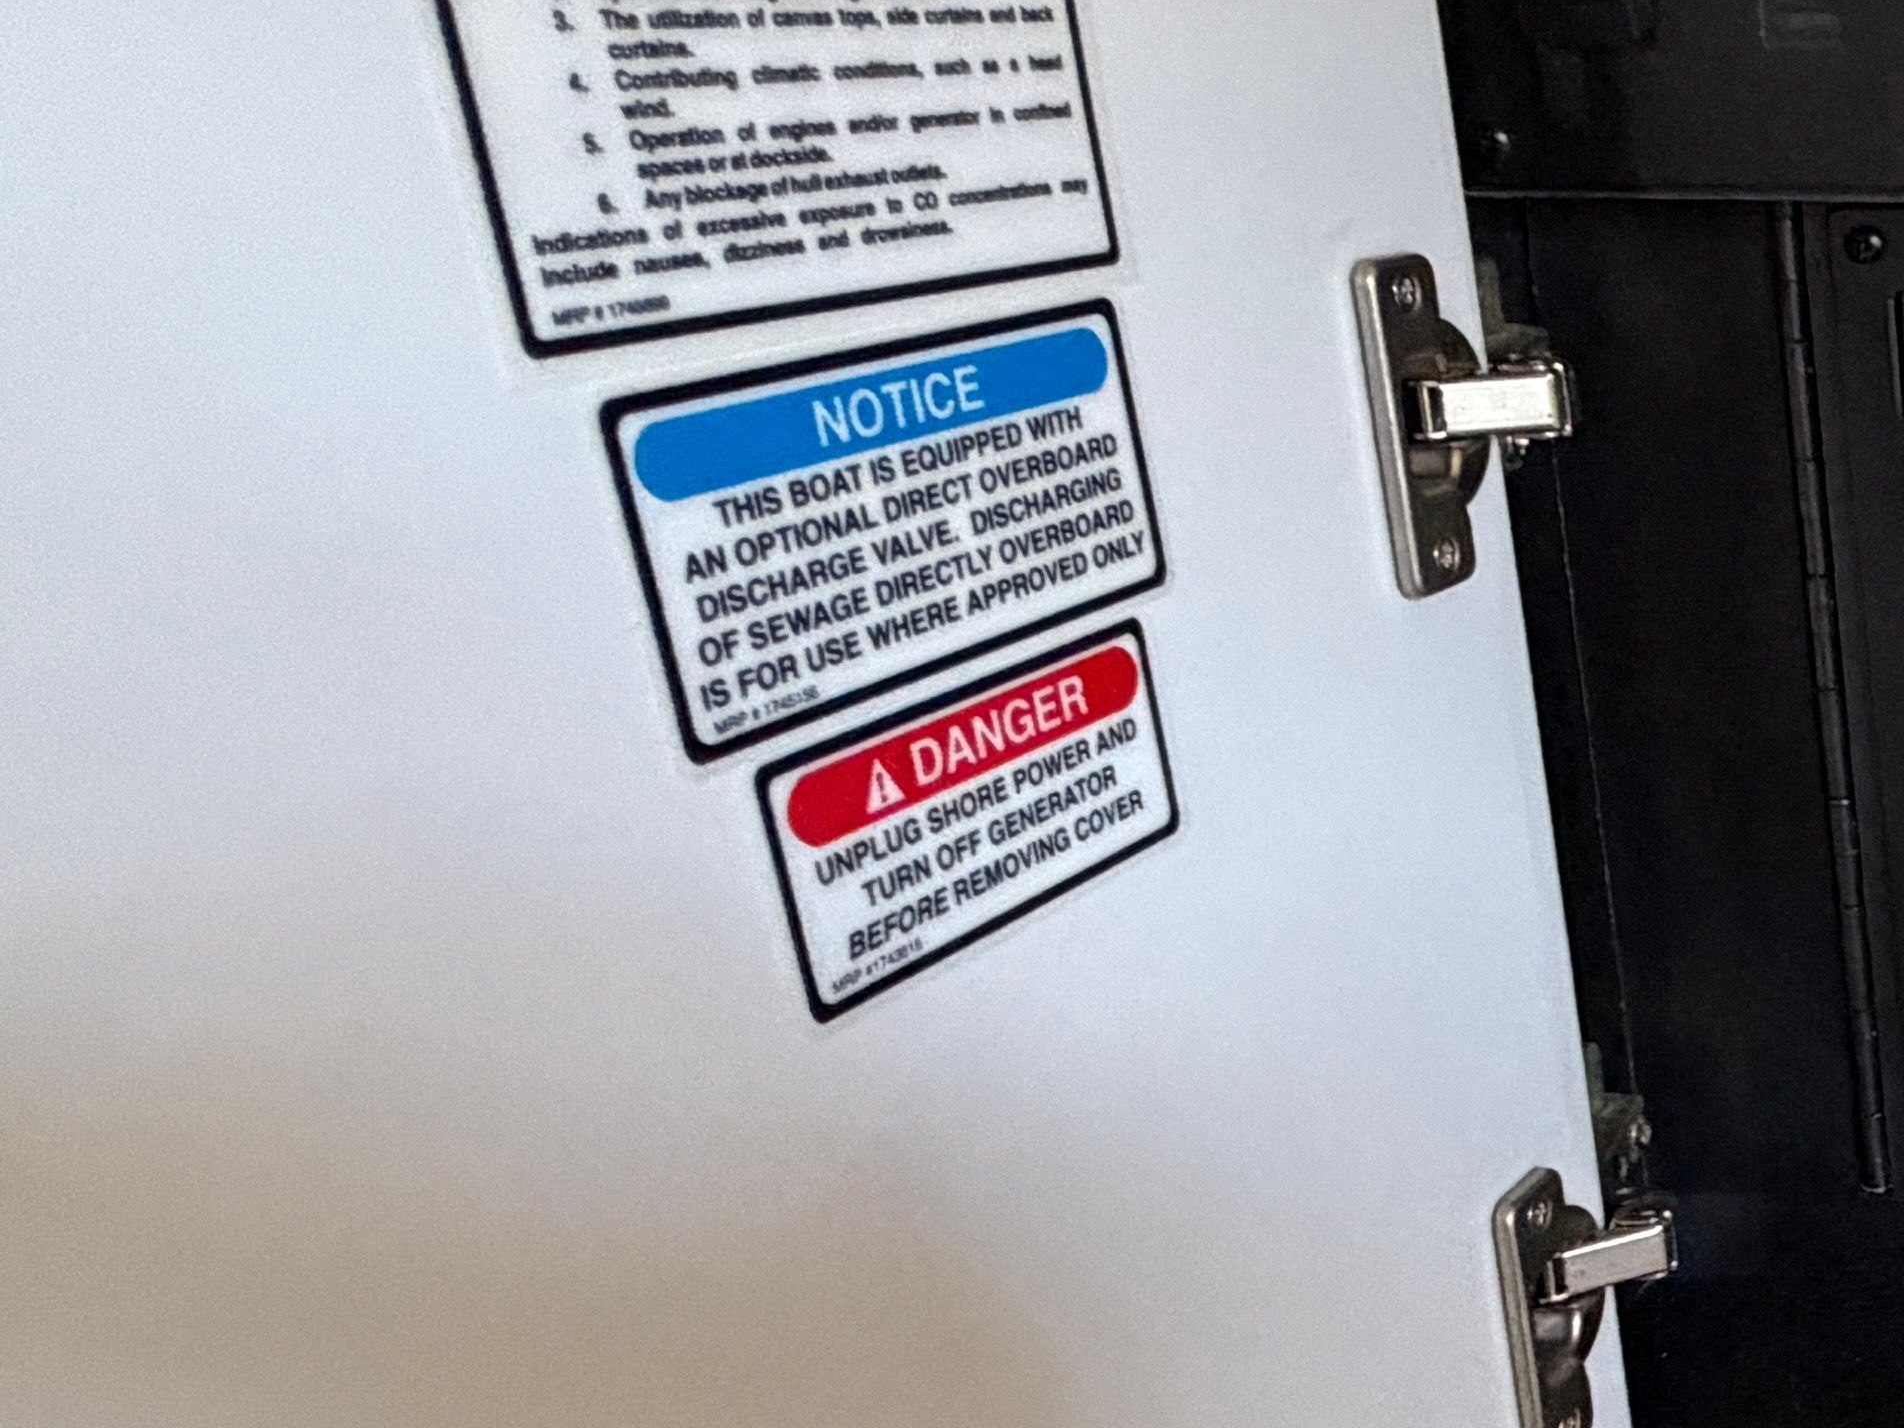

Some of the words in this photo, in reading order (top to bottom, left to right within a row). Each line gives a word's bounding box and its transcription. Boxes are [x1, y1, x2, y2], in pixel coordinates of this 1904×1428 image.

[712, 487, 782, 527] THIS
[789, 464, 863, 507] BOAT
[871, 456, 896, 485] IS
[902, 422, 1022, 474] EQUIPPED
[1026, 407, 1083, 441] WITH
[812, 365, 985, 447] NOTICE
[684, 545, 728, 583] AN
[734, 507, 880, 568] OPTIONAL
[884, 473, 972, 520] DIRECT
[979, 433, 1119, 492] OVERBOARD
[695, 547, 868, 622] DISCHARGE
[872, 517, 960, 563] VALVE.
[970, 469, 1123, 535] DISCHARGING
[698, 629, 740, 666] OF
[748, 585, 871, 650] SEWAGE
[876, 541, 994, 605] DIRECTLY
[999, 500, 1135, 563] OVERBOARD
[700, 679, 732, 711] IS
[737, 654, 801, 696] FOR
[805, 632, 863, 671] USE
[866, 595, 960, 648] WHERE
[967, 555, 1088, 616] APPROVED
[1091, 530, 1146, 571] ONLY
[814, 818, 922, 886] UNPLUG
[926, 777, 1010, 833] SHORE
[1012, 739, 1092, 793] POWER
[1095, 718, 1137, 754] AND
[909, 675, 1089, 786] DANGER
[848, 887, 951, 960] BEFORE
[952, 828, 1072, 904] REMOVING
[1073, 790, 1144, 841] COVER
[861, 855, 934, 904] TURN
[935, 830, 982, 871] OFF
[987, 766, 1118, 846] GENERATOR
